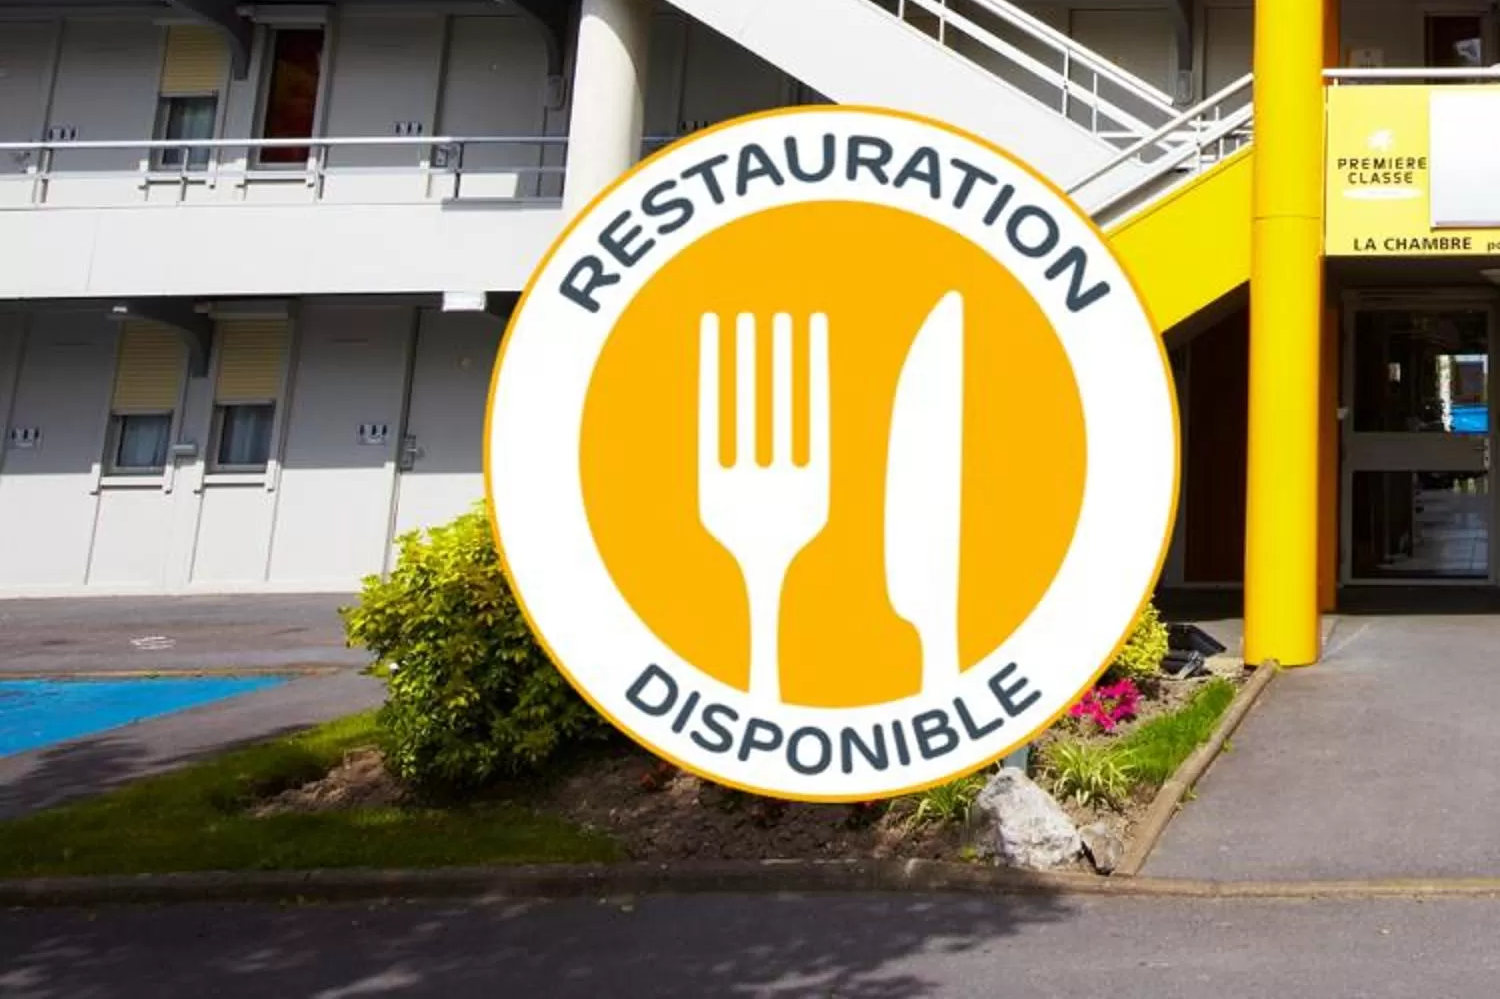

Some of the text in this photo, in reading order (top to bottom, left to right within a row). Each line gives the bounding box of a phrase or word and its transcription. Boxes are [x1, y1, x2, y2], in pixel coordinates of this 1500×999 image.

[1337, 156, 1427, 171] PREMIERE
[1347, 172, 1414, 185] CLASSE
[1353, 237, 1377, 252] LA
[1383, 236, 1473, 251] CHAMBRE
